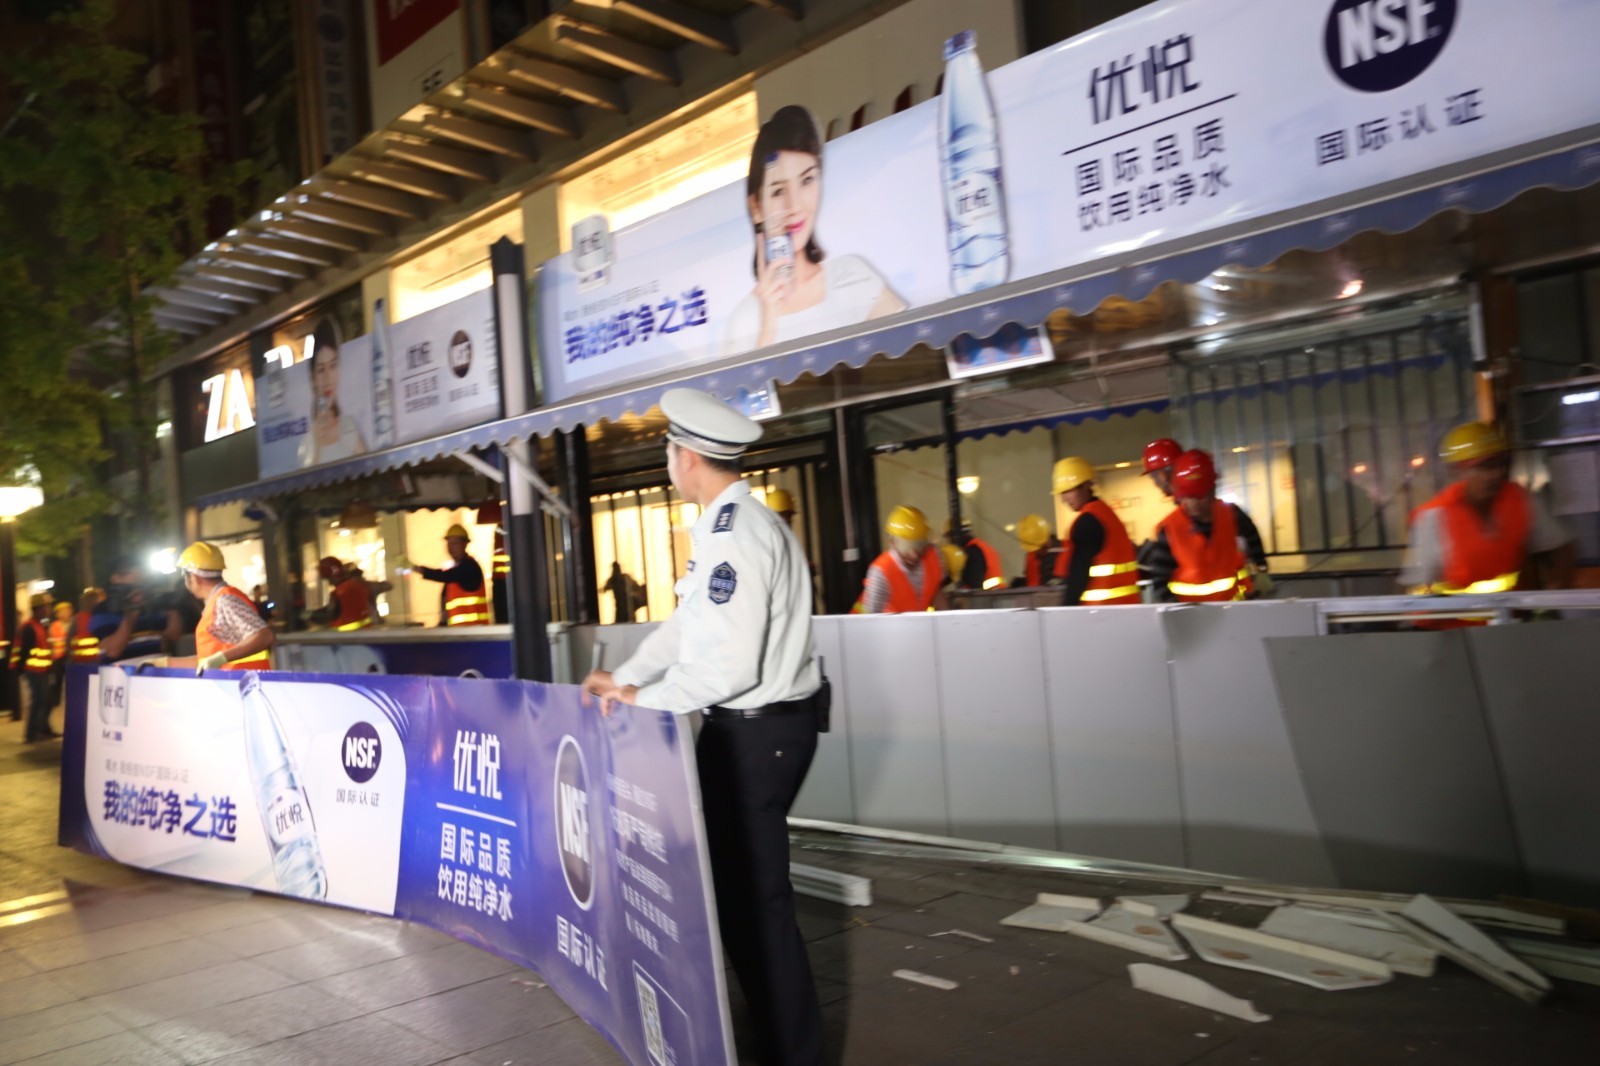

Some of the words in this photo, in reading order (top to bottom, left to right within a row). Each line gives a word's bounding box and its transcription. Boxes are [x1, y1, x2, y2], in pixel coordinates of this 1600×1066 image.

[1337, 0, 1436, 69] NSF
[1088, 33, 1200, 125] 优悦
[1076, 116, 1225, 198] 国际品质
[1315, 87, 1485, 167] 国际认证
[1079, 162, 1233, 233] 饮用纯净水
[346, 736, 378, 769] NSF
[453, 730, 502, 800] 优悦
[103, 779, 238, 843] 我的纯净之选
[336, 788, 380, 807] 国际认证
[440, 822, 512, 880] 国际品质
[437, 862, 513, 922] 饮用纯净水
[556, 914, 608, 992] 国际认证
